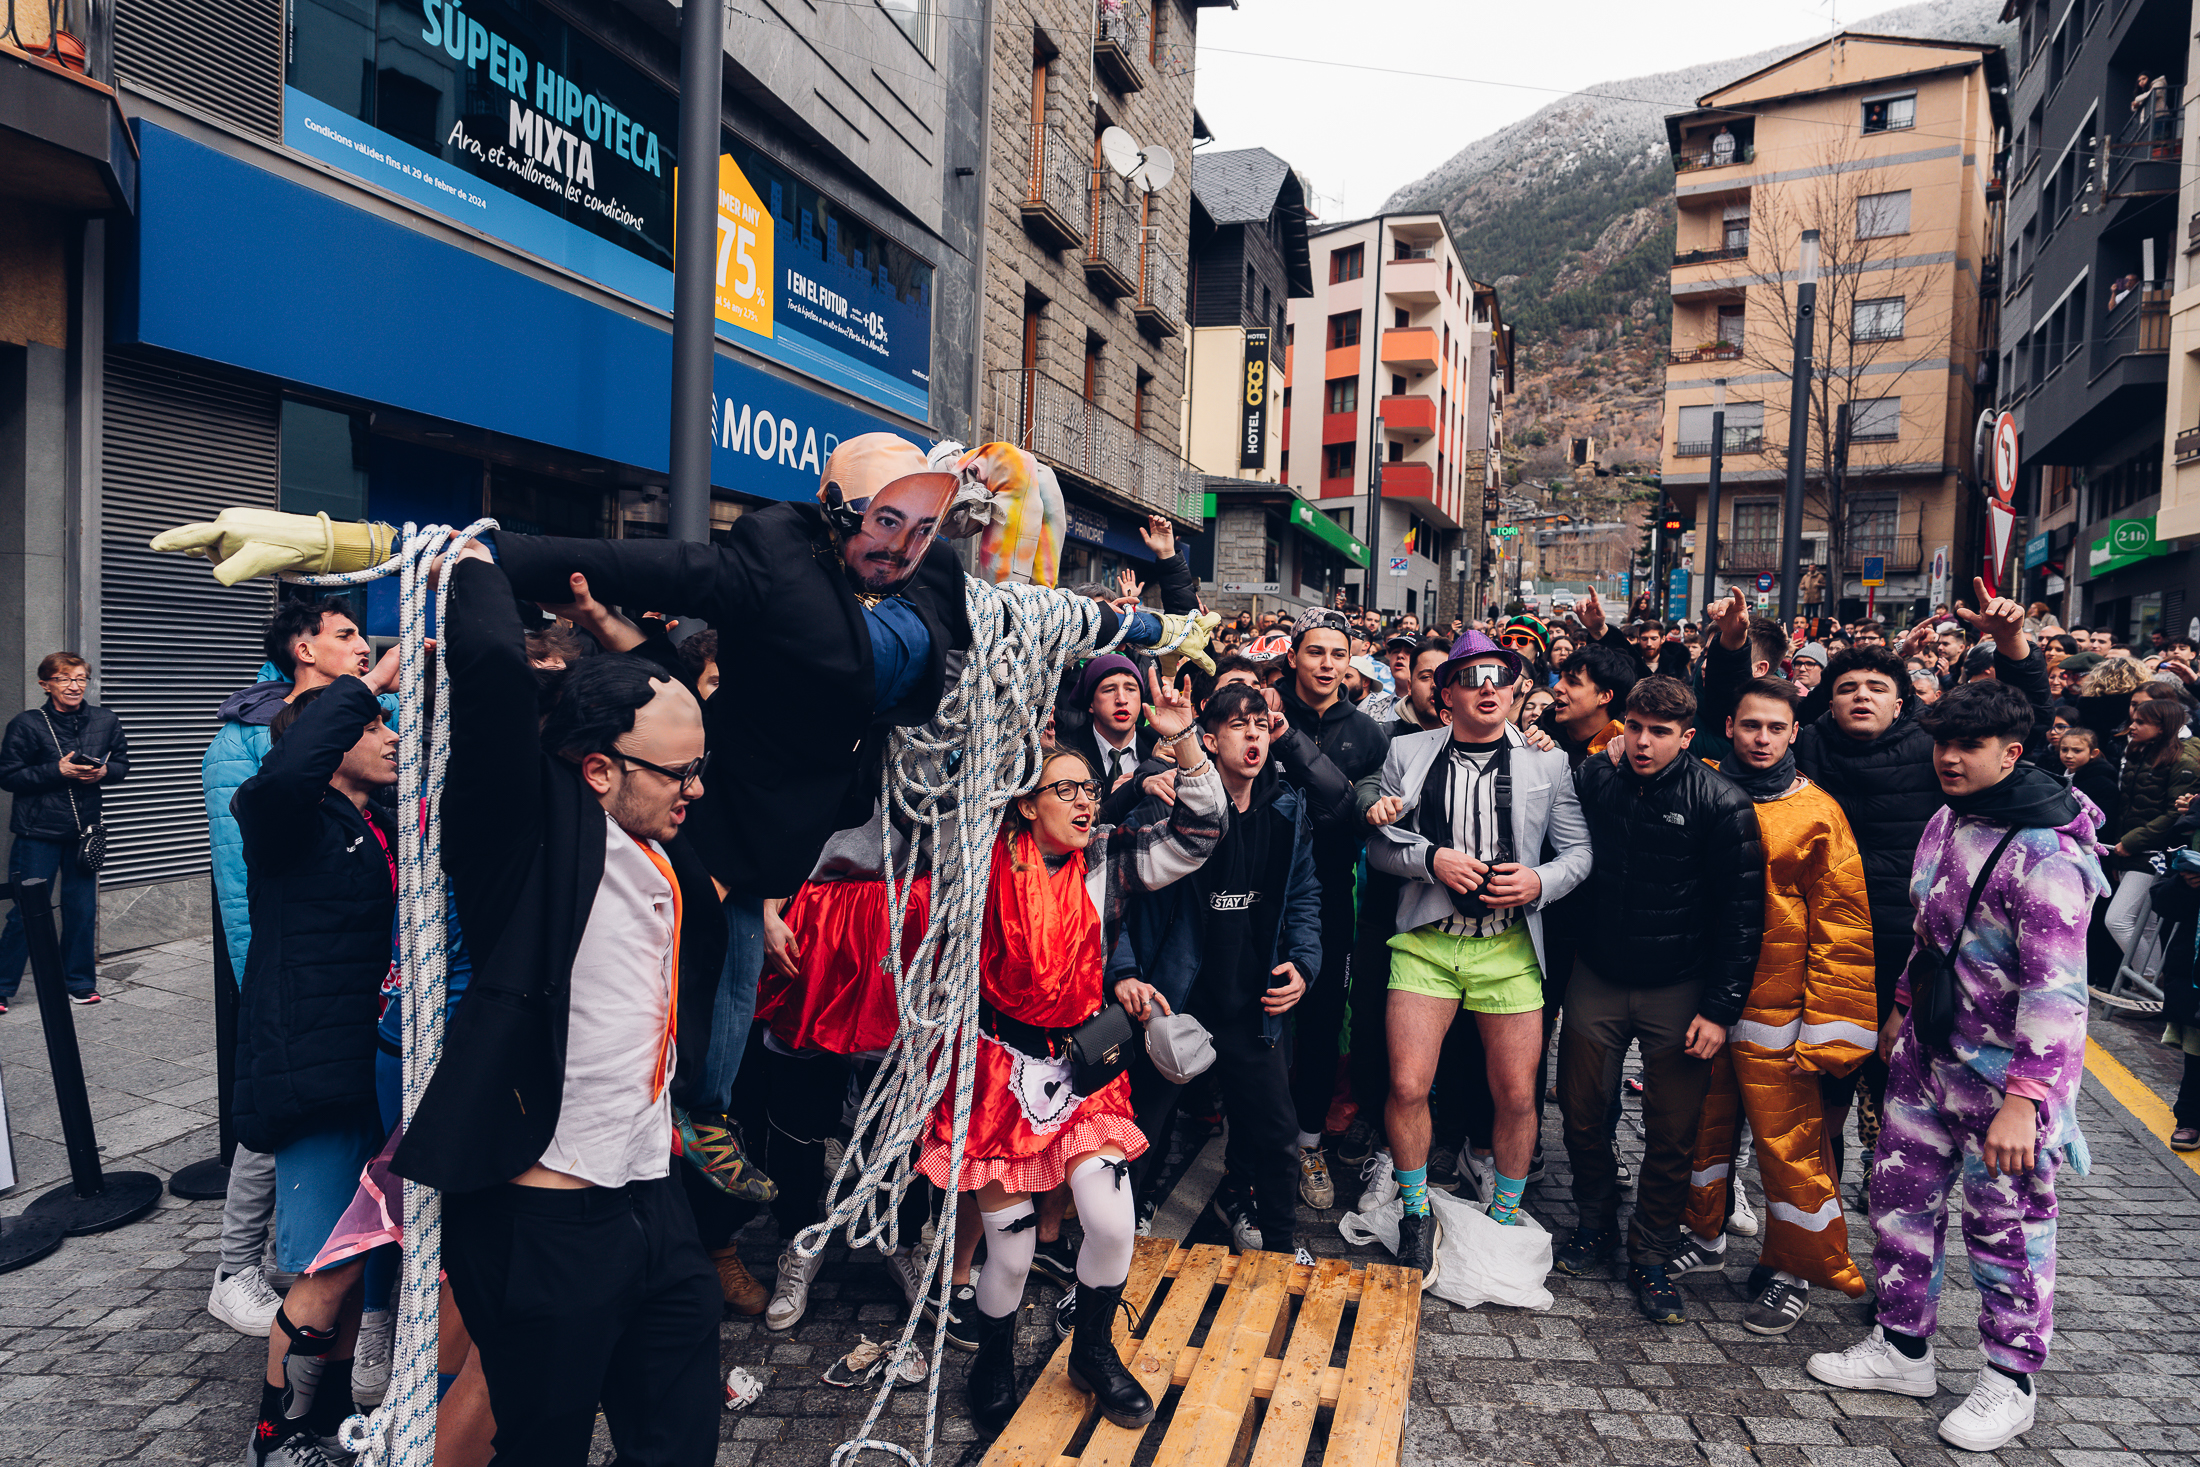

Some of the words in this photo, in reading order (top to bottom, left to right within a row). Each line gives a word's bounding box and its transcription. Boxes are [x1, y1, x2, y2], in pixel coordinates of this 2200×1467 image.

[422, 0, 528, 100] SÚPER
[536, 61, 661, 178] HIPOTECA
[304, 117, 352, 148] Condicions
[354, 142, 384, 163] vàlides
[385, 155, 401, 170] fins
[402, 163, 411, 175] al
[412, 167, 422, 179] 29
[423, 173, 433, 185] de
[434, 177, 456, 195] febrer
[457, 188, 467, 201] de
[468, 193, 487, 209] 2024
[509, 99, 595, 190] MIXTA
[448, 120, 485, 162] Ara,
[488, 146, 504, 167] et
[508, 155, 563, 195] millorem
[565, 178, 582, 203] les
[584, 197, 644, 231] condicions
[719, 188, 741, 217] IMER
[741, 203, 760, 228] ANY
[732, 304, 743, 317] any
[793, 271, 807, 298] EN
[807, 279, 819, 304] EL
[819, 286, 848, 320] FUTUR
[1246, 360, 1264, 406] OROS
[1247, 411, 1260, 454] HOTEL
[2118, 531, 2146, 542] 24h
[1214, 897, 1242, 908] STAY
